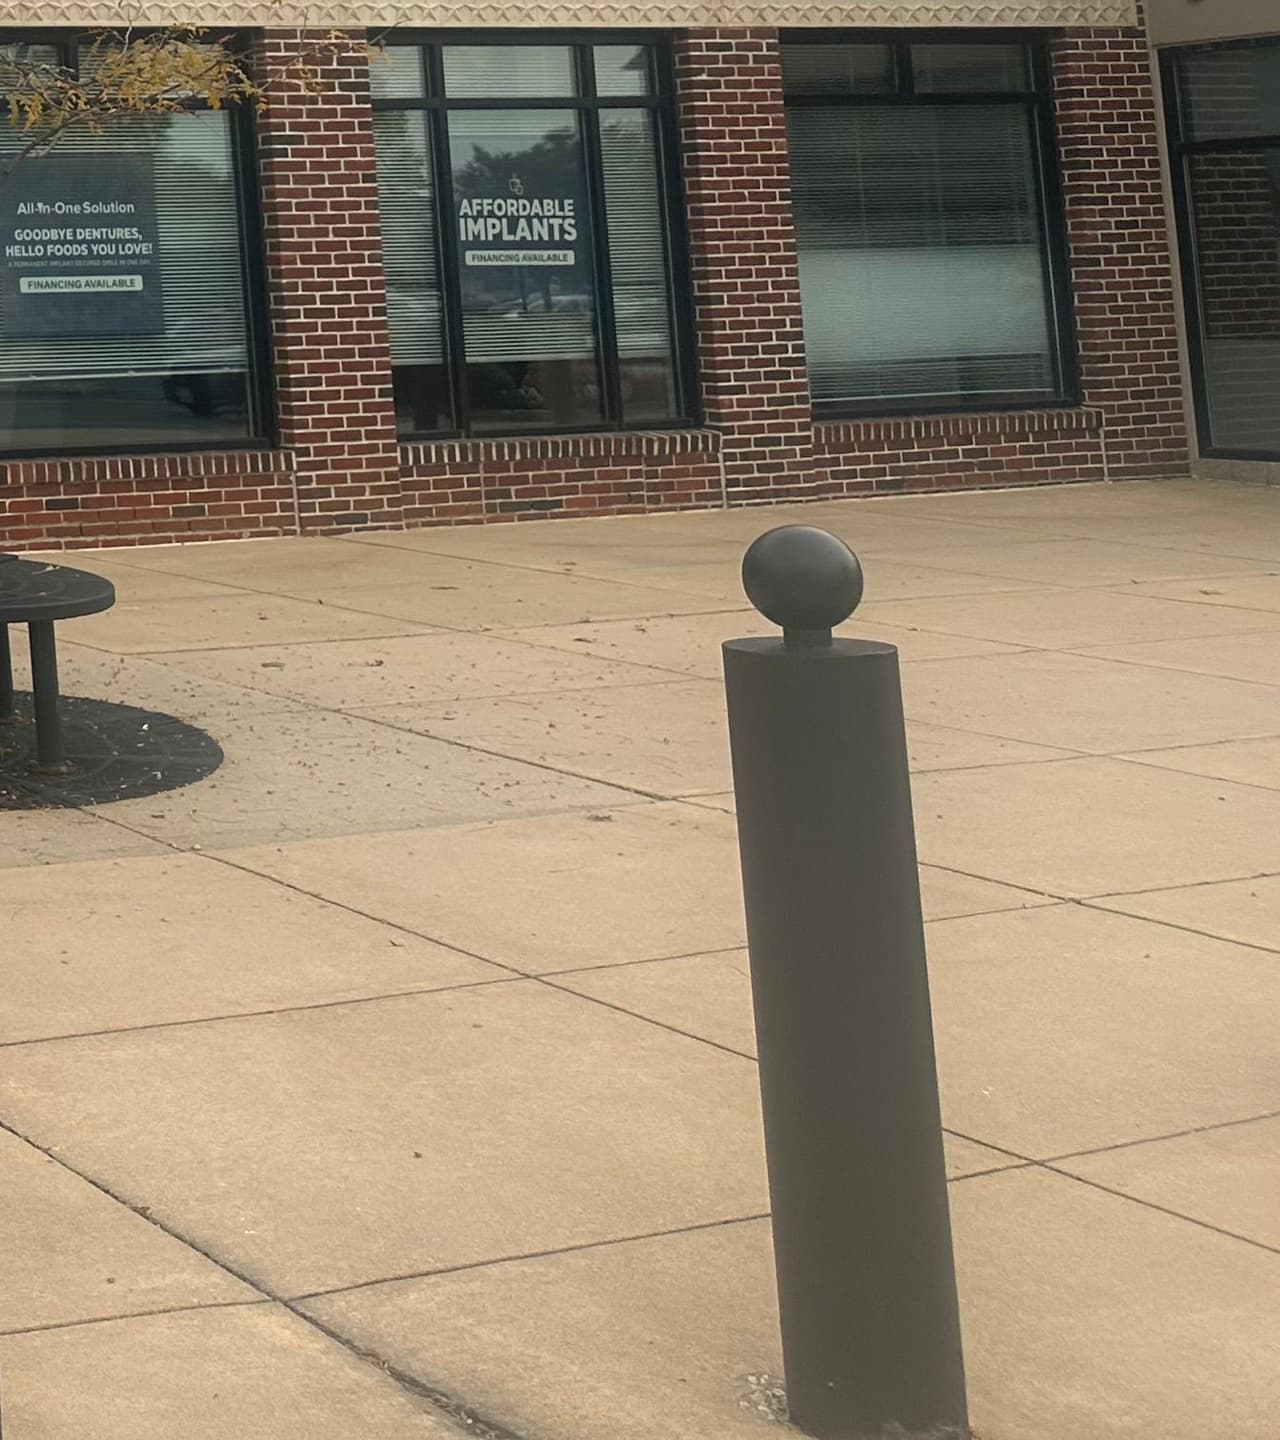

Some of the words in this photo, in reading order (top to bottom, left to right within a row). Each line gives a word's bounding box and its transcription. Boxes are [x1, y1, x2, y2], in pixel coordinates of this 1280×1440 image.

[82, 201, 135, 213] Solution
[459, 198, 575, 216] AFFORDABLE
[14, 228, 74, 241] GOODBYE
[76, 227, 143, 241] DENTURES,
[459, 217, 577, 241] IMPLANTS
[5, 245, 44, 257] HELLO
[46, 244, 89, 256] FOODS
[90, 243, 116, 255] YOU
[118, 243, 153, 254] LOVE!
[471, 253, 520, 262] FINANCING
[521, 253, 568, 262] AVAILABLE
[27, 280, 82, 289] FINANCING
[84, 278, 136, 288] AVAILABLE
